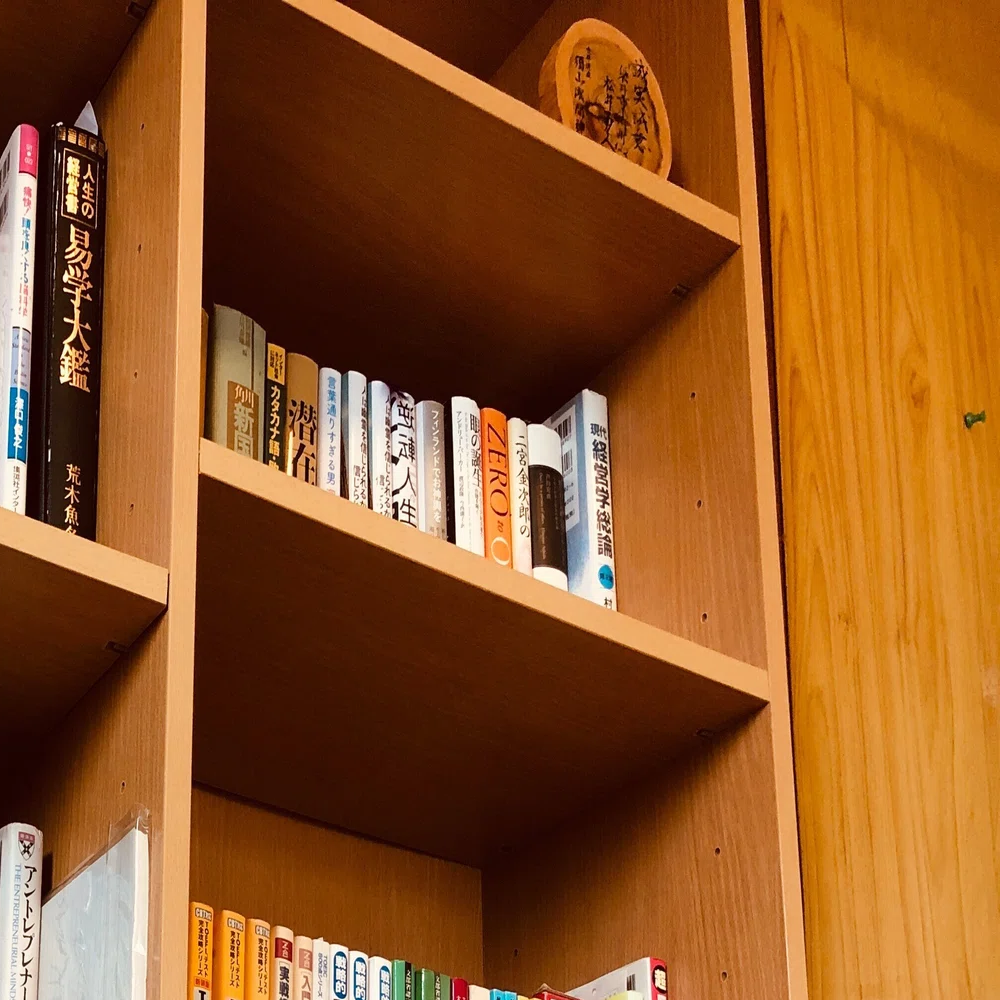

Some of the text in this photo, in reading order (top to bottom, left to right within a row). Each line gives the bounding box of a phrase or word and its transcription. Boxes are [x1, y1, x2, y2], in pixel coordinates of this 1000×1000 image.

[81, 164, 95, 220] 人生の
[58, 224, 93, 394] 易学大鑑
[234, 386, 254, 409] 角川
[327, 376, 336, 486] 言葉通りすぎる男
[590, 423, 608, 441] 現代
[288, 400, 317, 486] 潜在
[469, 414, 482, 487] 眼の誕生
[515, 435, 530, 538] 二宮金次郎の
[591, 440, 613, 559] 経営学総論
